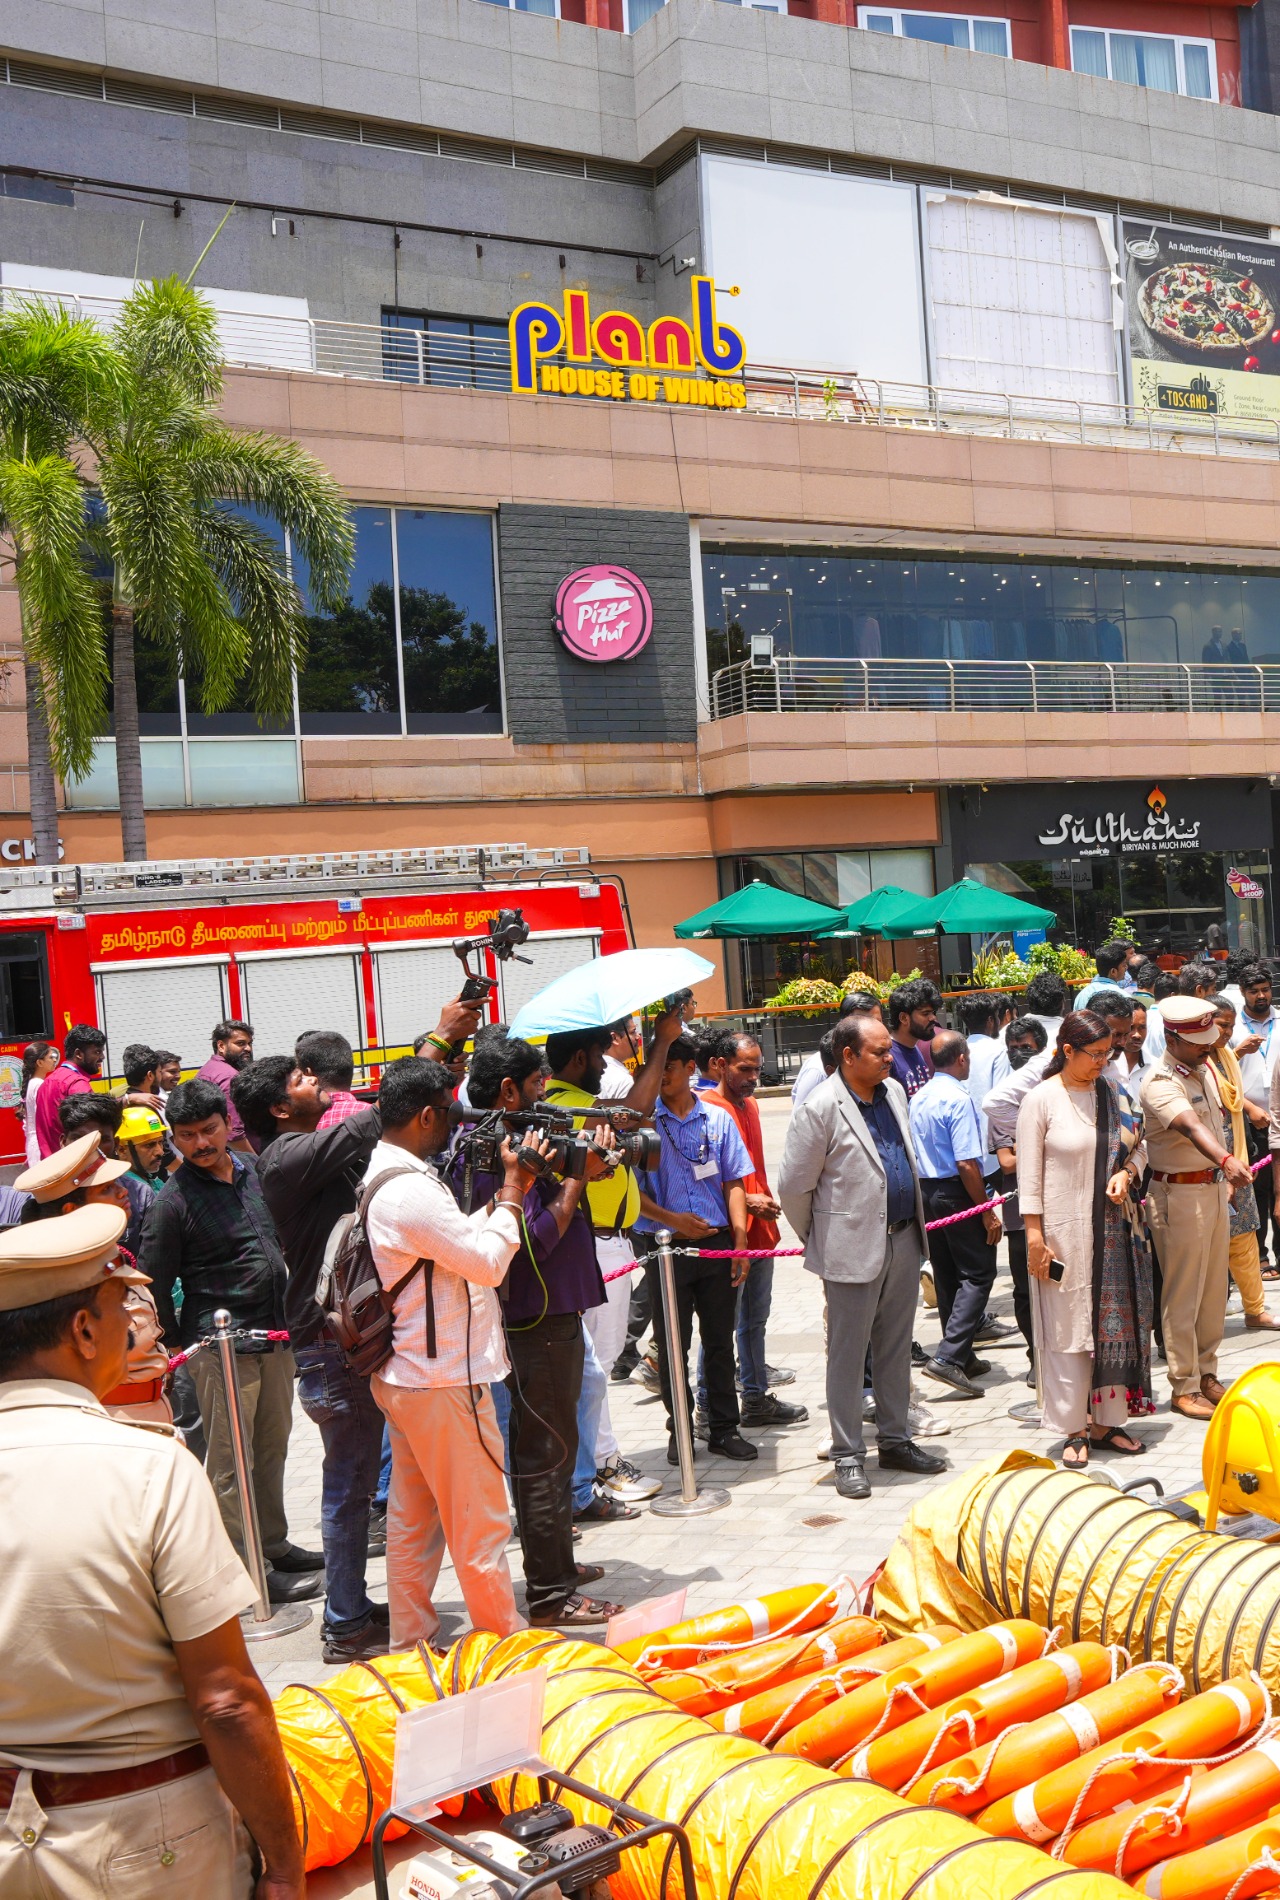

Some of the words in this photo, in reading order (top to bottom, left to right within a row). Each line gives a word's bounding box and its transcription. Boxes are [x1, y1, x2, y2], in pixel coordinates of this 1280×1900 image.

[1168, 241, 1178, 250] An
[541, 365, 626, 399] HOUSE
[629, 374, 659, 400] OF
[663, 377, 747, 408] WINGS
[1166, 390, 1208, 410] TOSCANO
[577, 600, 632, 631] Pizza
[589, 620, 630, 647] Hut
[1038, 811, 1201, 845] Sulthan's
[1121, 842, 1150, 852] BIRIYANI
[1158, 842, 1179, 850] MUCH
[1180, 840, 1200, 849] MORE
[1241, 882, 1256, 892] BIG
[100, 925, 186, 954] தமிழ்நாடு
[191, 918, 287, 949] தீயணைப்பு
[292, 914, 347, 941] மற்றும்
[353, 907, 459, 935] மீட்புப்பணிகள்
[471, 937, 493, 948] RONIN
[411, 1875, 441, 1900] HONDA
